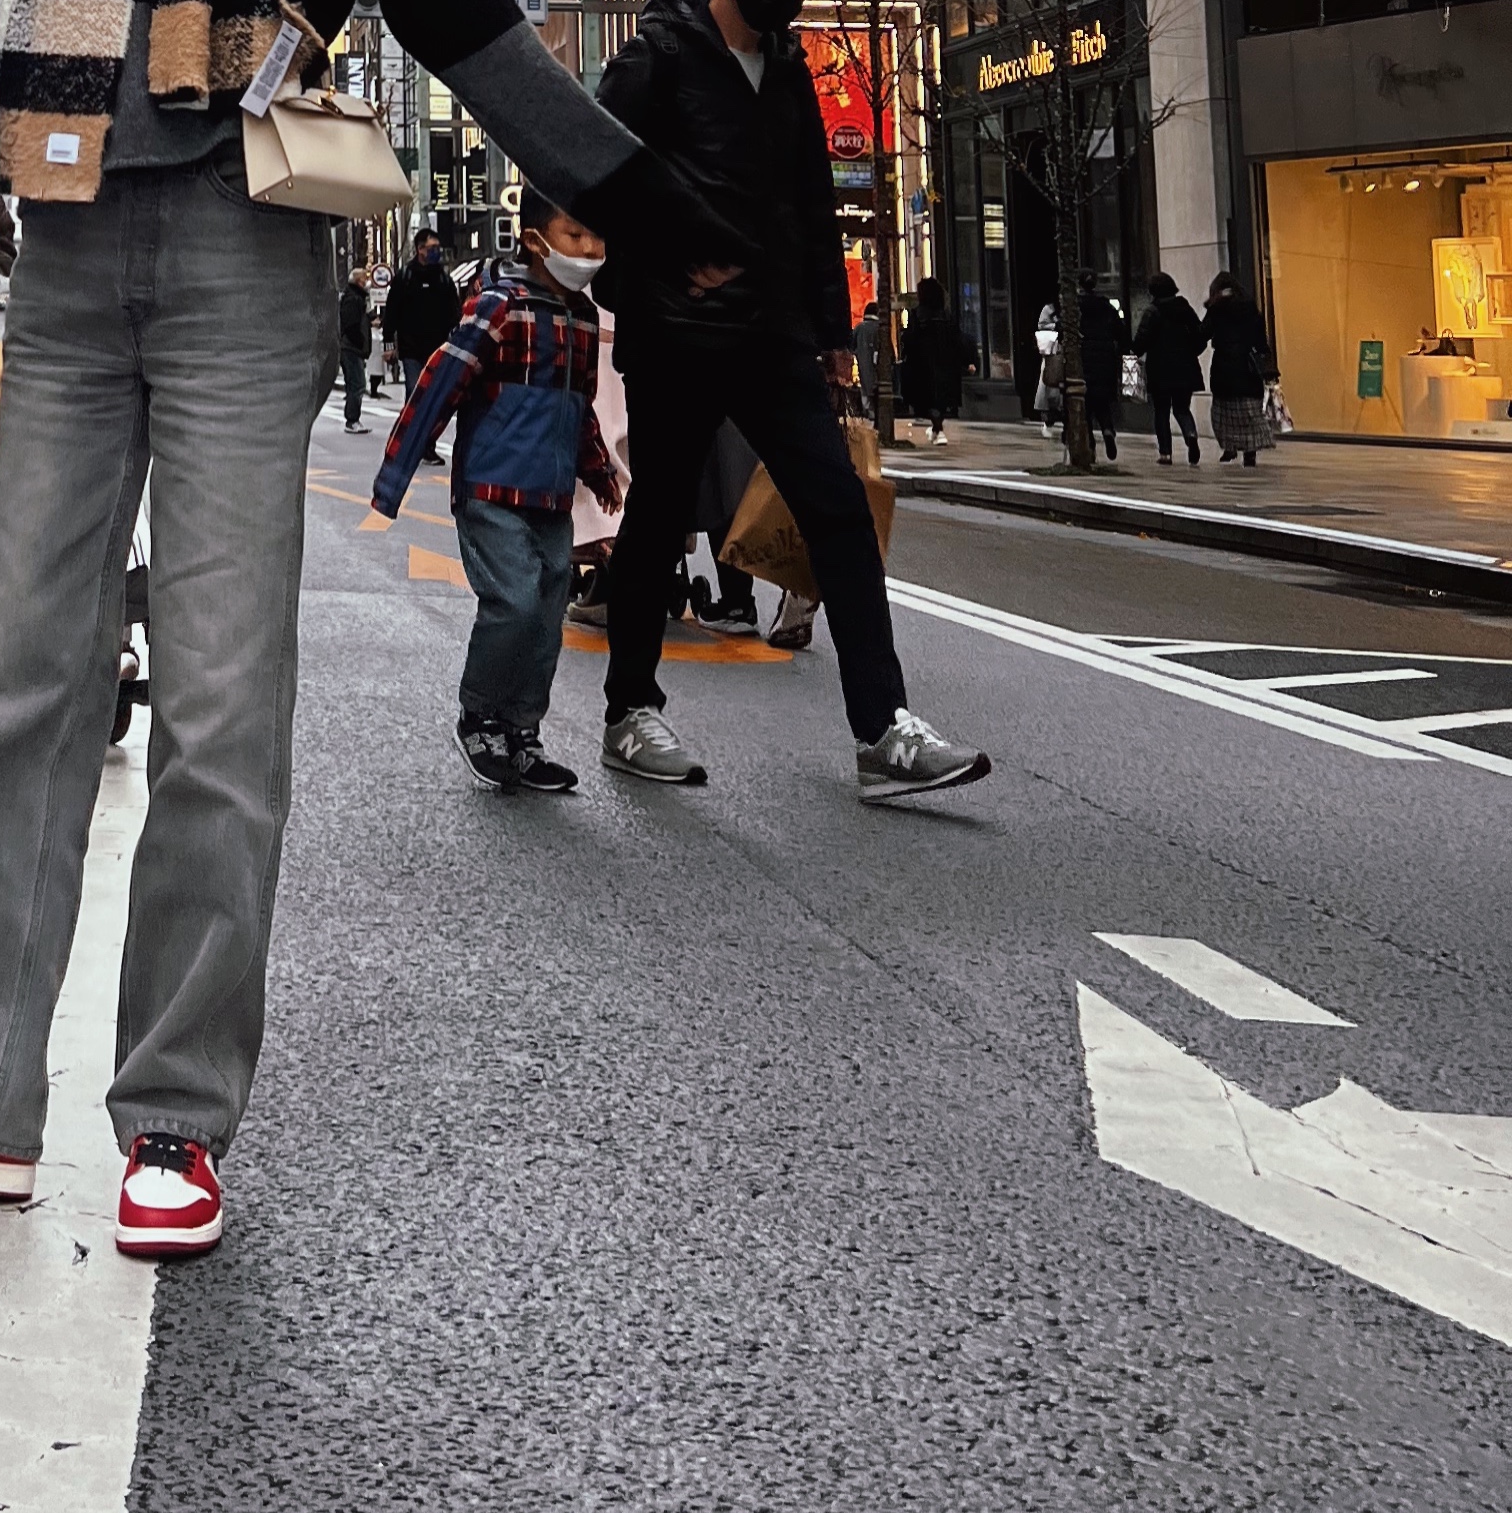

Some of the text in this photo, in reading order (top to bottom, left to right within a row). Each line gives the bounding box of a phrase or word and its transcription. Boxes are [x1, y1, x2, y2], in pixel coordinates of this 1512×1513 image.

[1070, 19, 1107, 66] Fitch
[834, 134, 864, 149] 消火栓
[434, 172, 450, 211] PIAGET
[616, 732, 643, 761] N
